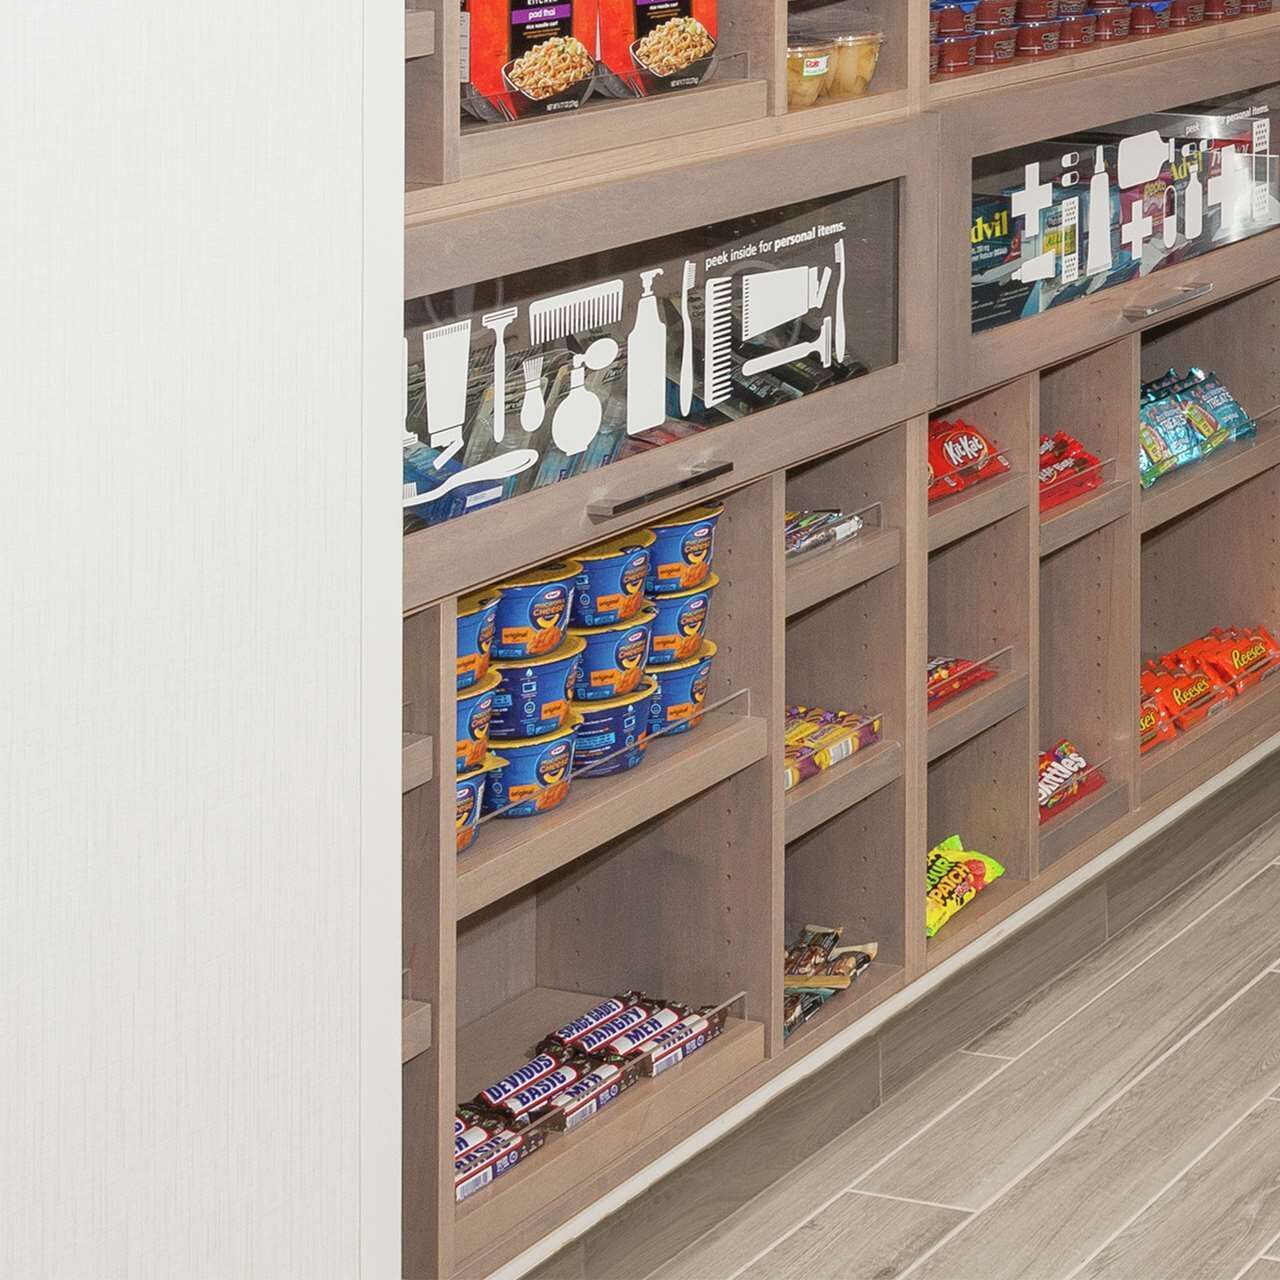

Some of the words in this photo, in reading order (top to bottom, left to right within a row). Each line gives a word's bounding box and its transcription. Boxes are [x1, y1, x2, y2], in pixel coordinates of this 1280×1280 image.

[528, 9, 543, 21] pad
[543, 7, 556, 17] thai
[1185, 122, 1200, 137] peek
[1225, 106, 1252, 126] personal
[970, 209, 1009, 245] dvil
[705, 251, 729, 271] peek
[730, 243, 757, 262] inside
[759, 239, 774, 254] for
[774, 226, 816, 253] personal
[817, 221, 847, 238] items.
[580, 1005, 644, 1050] HANGRY
[590, 998, 622, 1021] CADET
[625, 1017, 664, 1045] MEH
[485, 1053, 554, 1102] DEVIOUS
[516, 1069, 568, 1106] BASIC
